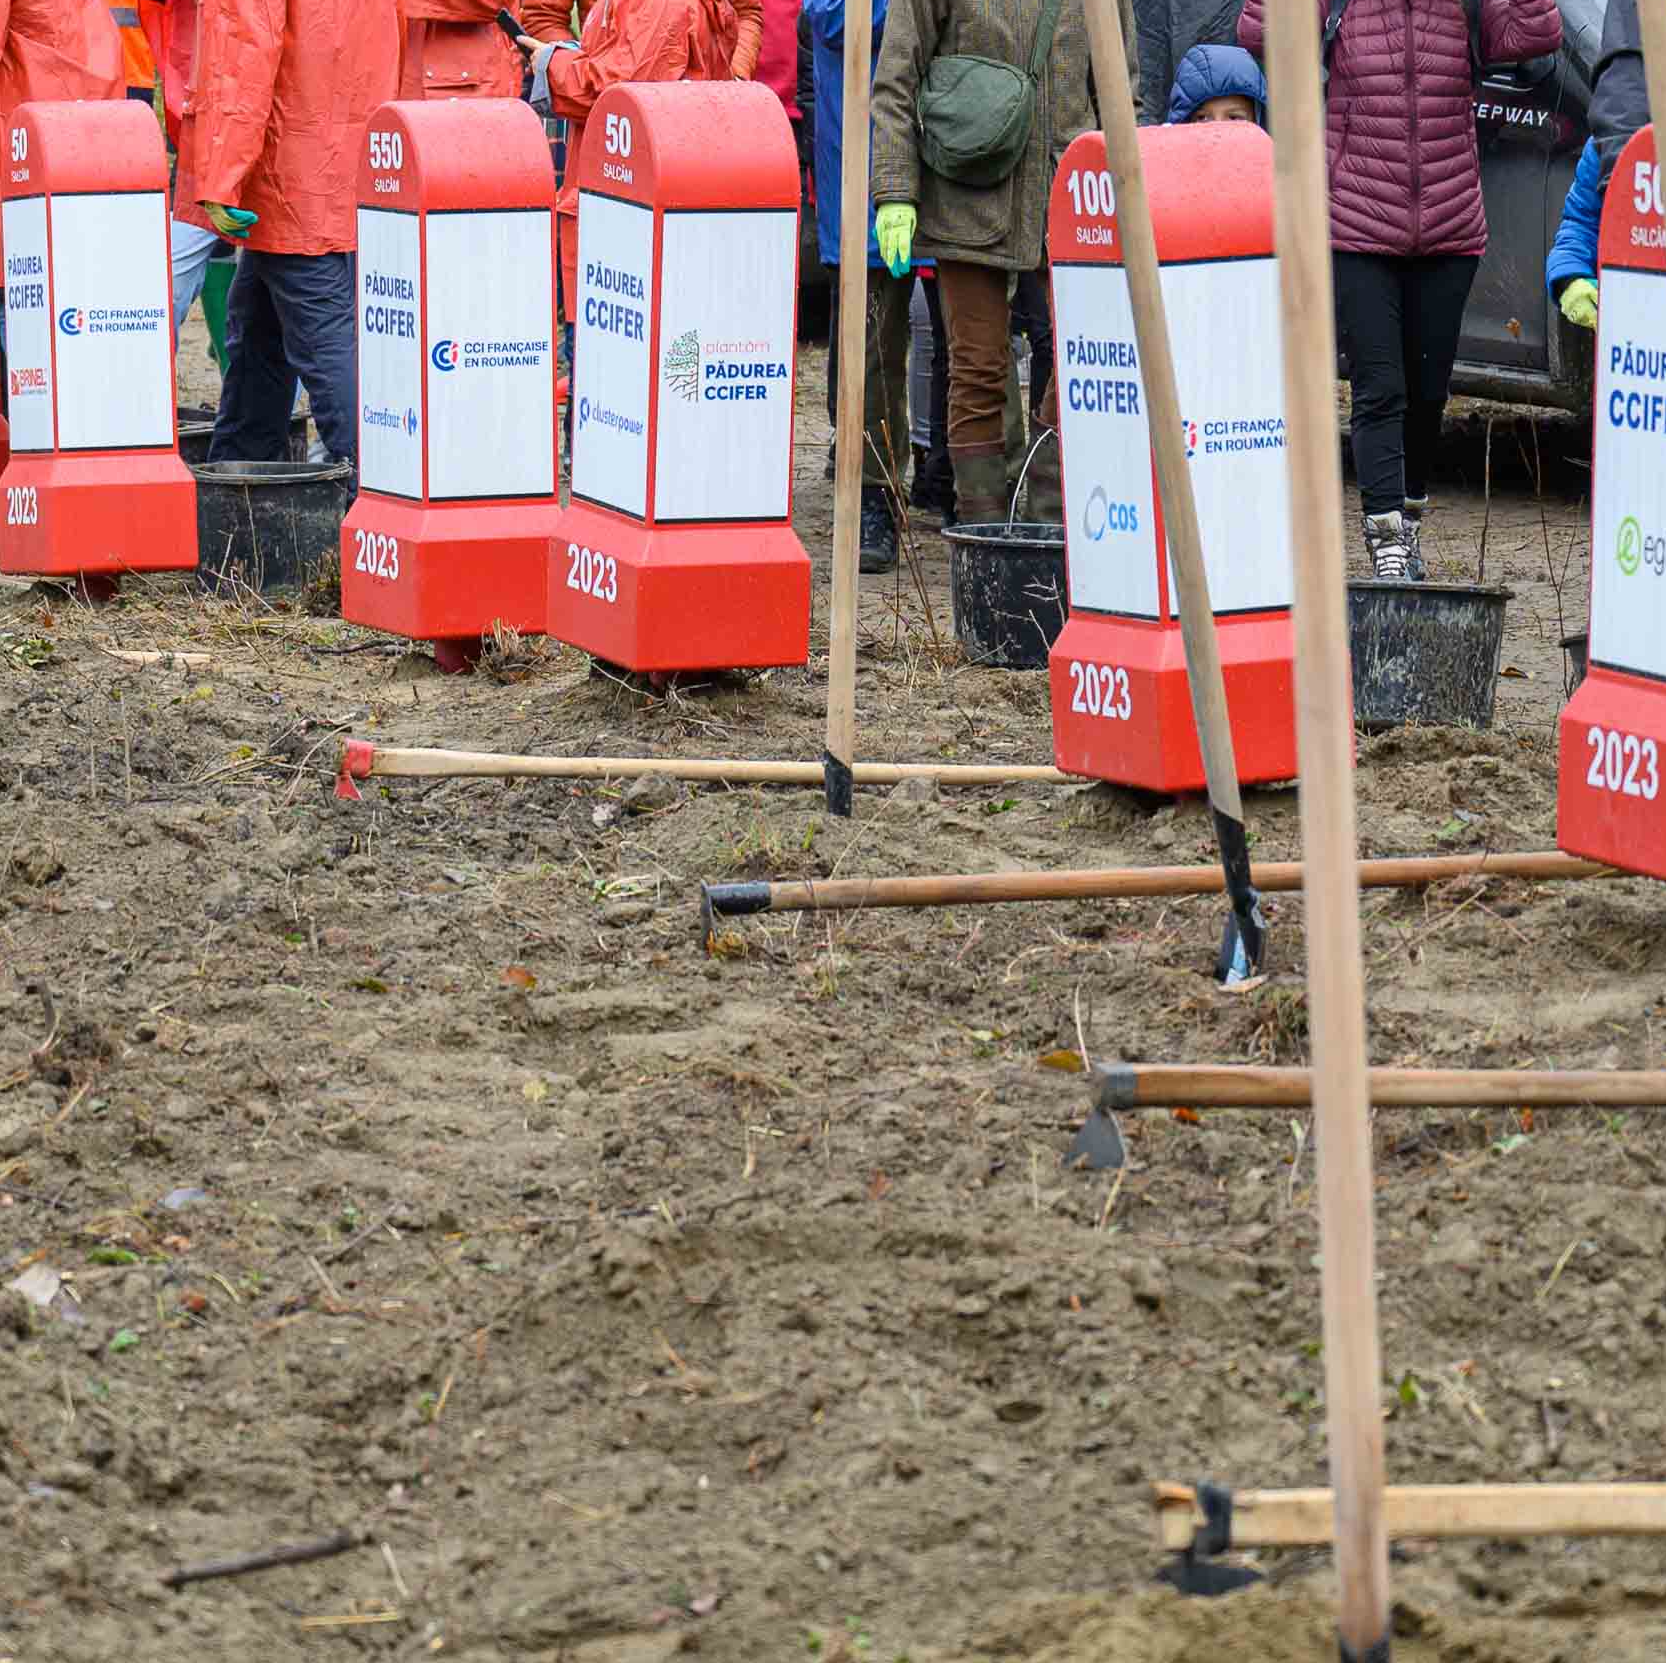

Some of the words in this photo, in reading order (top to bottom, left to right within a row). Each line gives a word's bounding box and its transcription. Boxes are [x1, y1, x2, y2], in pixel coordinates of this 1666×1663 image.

[1473, 102, 1549, 127] EPWAY
[12, 127, 28, 161] 50
[369, 132, 403, 169] 550
[604, 112, 632, 158] 50
[1068, 170, 1116, 217] 100
[8, 253, 44, 276] PĂDUREA
[585, 261, 645, 300] PĂDUREA
[8, 285, 45, 311] CCIFER
[365, 270, 415, 301] PĂDUREA
[89, 309, 109, 320] CCI
[112, 308, 166, 321] FRANÇAISE
[89, 323, 103, 332] EN
[105, 321, 158, 332] ROUMANIE
[365, 305, 416, 339] CCIFER
[585, 297, 645, 340] CCIFER
[464, 342, 484, 354] CCI
[486, 340, 549, 355] FRANÇAISE
[464, 358, 480, 368] EN
[482, 354, 540, 367] ROUMANIE
[1066, 335, 1137, 370] PĂDUREA
[705, 361, 788, 380] PĂDUREA
[704, 386, 768, 402] CCIFER
[1068, 377, 1140, 415] CCIFER
[363, 404, 401, 430] Carrefour
[591, 398, 645, 436] clusterpower
[1204, 421, 1229, 436] CCI
[1232, 418, 1285, 434] FRANÇA
[1205, 440, 1223, 454] EN
[1225, 435, 1287, 452] ROUMAN
[7, 487, 38, 525] 2023
[1108, 501, 1139, 533] COS
[355, 529, 399, 581] 2023
[566, 543, 618, 603] 2023
[1069, 660, 1132, 721] 2023
[1586, 725, 1659, 800] 2023
